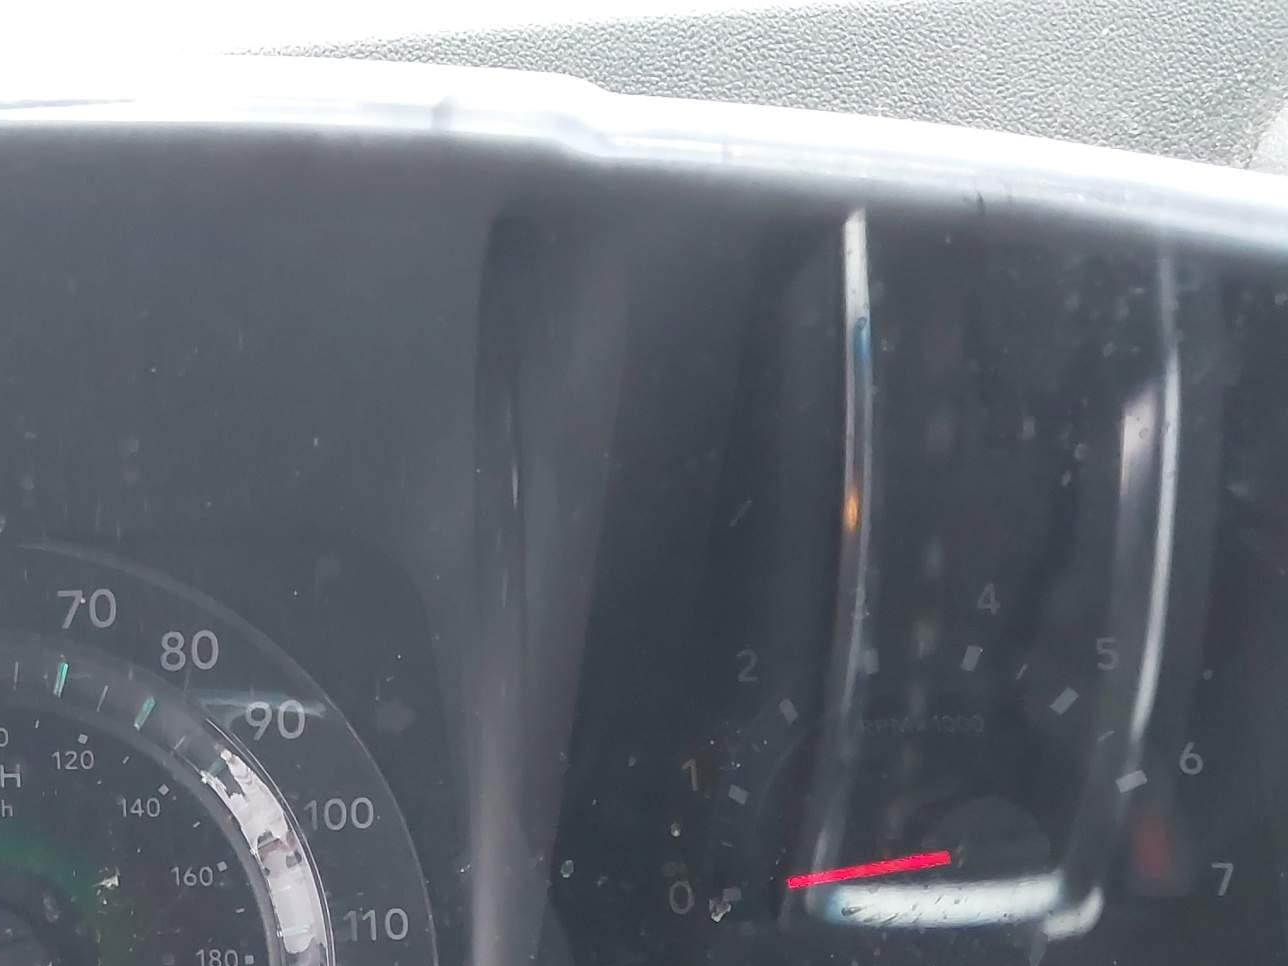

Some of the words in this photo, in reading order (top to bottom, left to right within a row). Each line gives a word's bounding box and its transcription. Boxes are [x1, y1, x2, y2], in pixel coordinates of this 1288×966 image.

[57, 588, 117, 628] 70
[977, 584, 1001, 616] 4
[160, 630, 220, 671] 80
[736, 650, 758, 683] 2
[1096, 638, 1119, 671] 5
[244, 700, 306, 740] 90
[52, 752, 95, 771] 120
[682, 760, 699, 791] 1
[1180, 744, 1204, 776] 6
[119, 798, 161, 818] 140
[306, 797, 375, 831] 100
[172, 866, 214, 887] 160
[1212, 862, 1234, 897] 7
[669, 880, 694, 915] 0
[345, 908, 409, 942] 110
